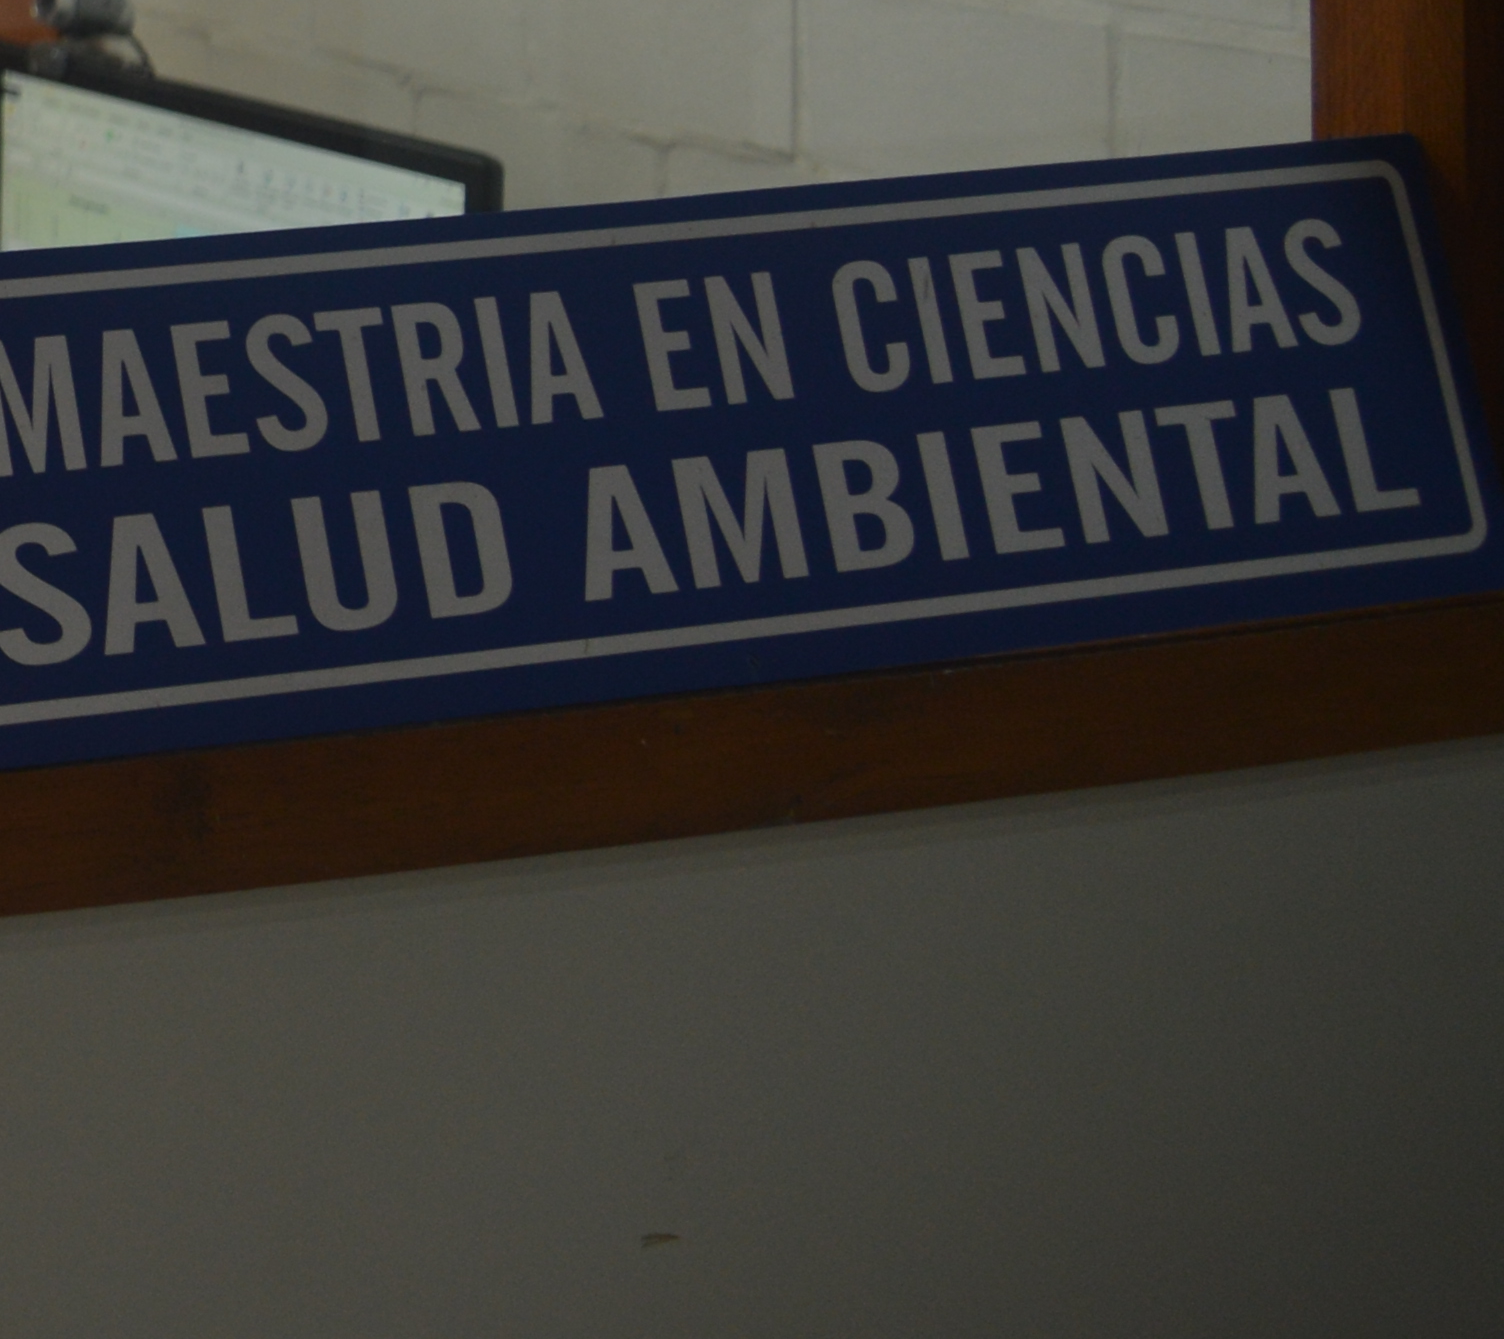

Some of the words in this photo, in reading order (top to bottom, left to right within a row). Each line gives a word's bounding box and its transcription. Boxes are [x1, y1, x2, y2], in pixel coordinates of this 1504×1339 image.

[632, 271, 795, 412] EN
[831, 218, 1363, 393] CIENCIAS
[583, 386, 1422, 603] AMBIENTAL
